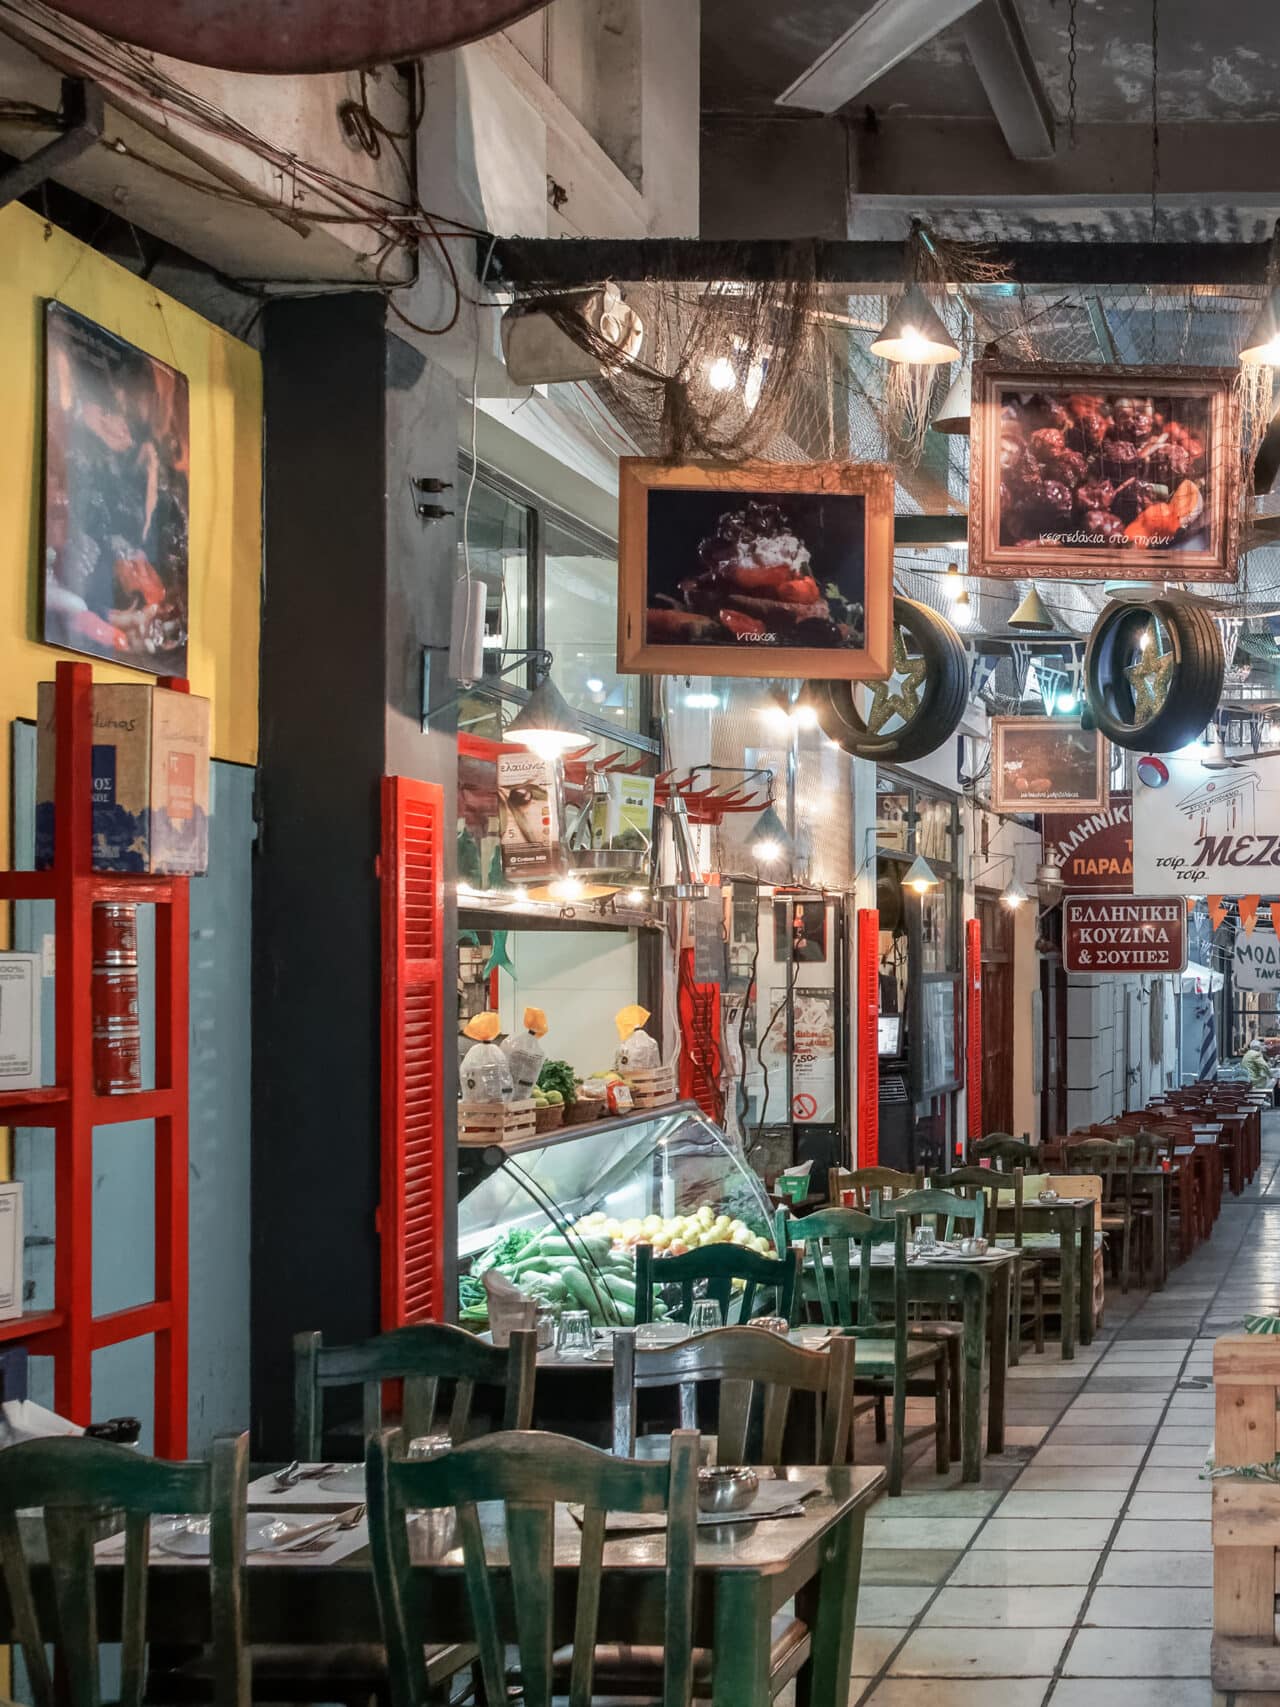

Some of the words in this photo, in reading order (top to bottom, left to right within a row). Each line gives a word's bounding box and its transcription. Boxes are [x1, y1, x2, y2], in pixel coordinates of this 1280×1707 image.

[1108, 533, 1129, 545] στο
[1070, 906, 1179, 922] ΕΛΛΗΝΙΚΗ
[1079, 927, 1170, 943] ΚΟΥΖΙΝΑ
[1078, 949, 1092, 964] &
[1096, 950, 1169, 964] ΣΟΥΠΕΣ
